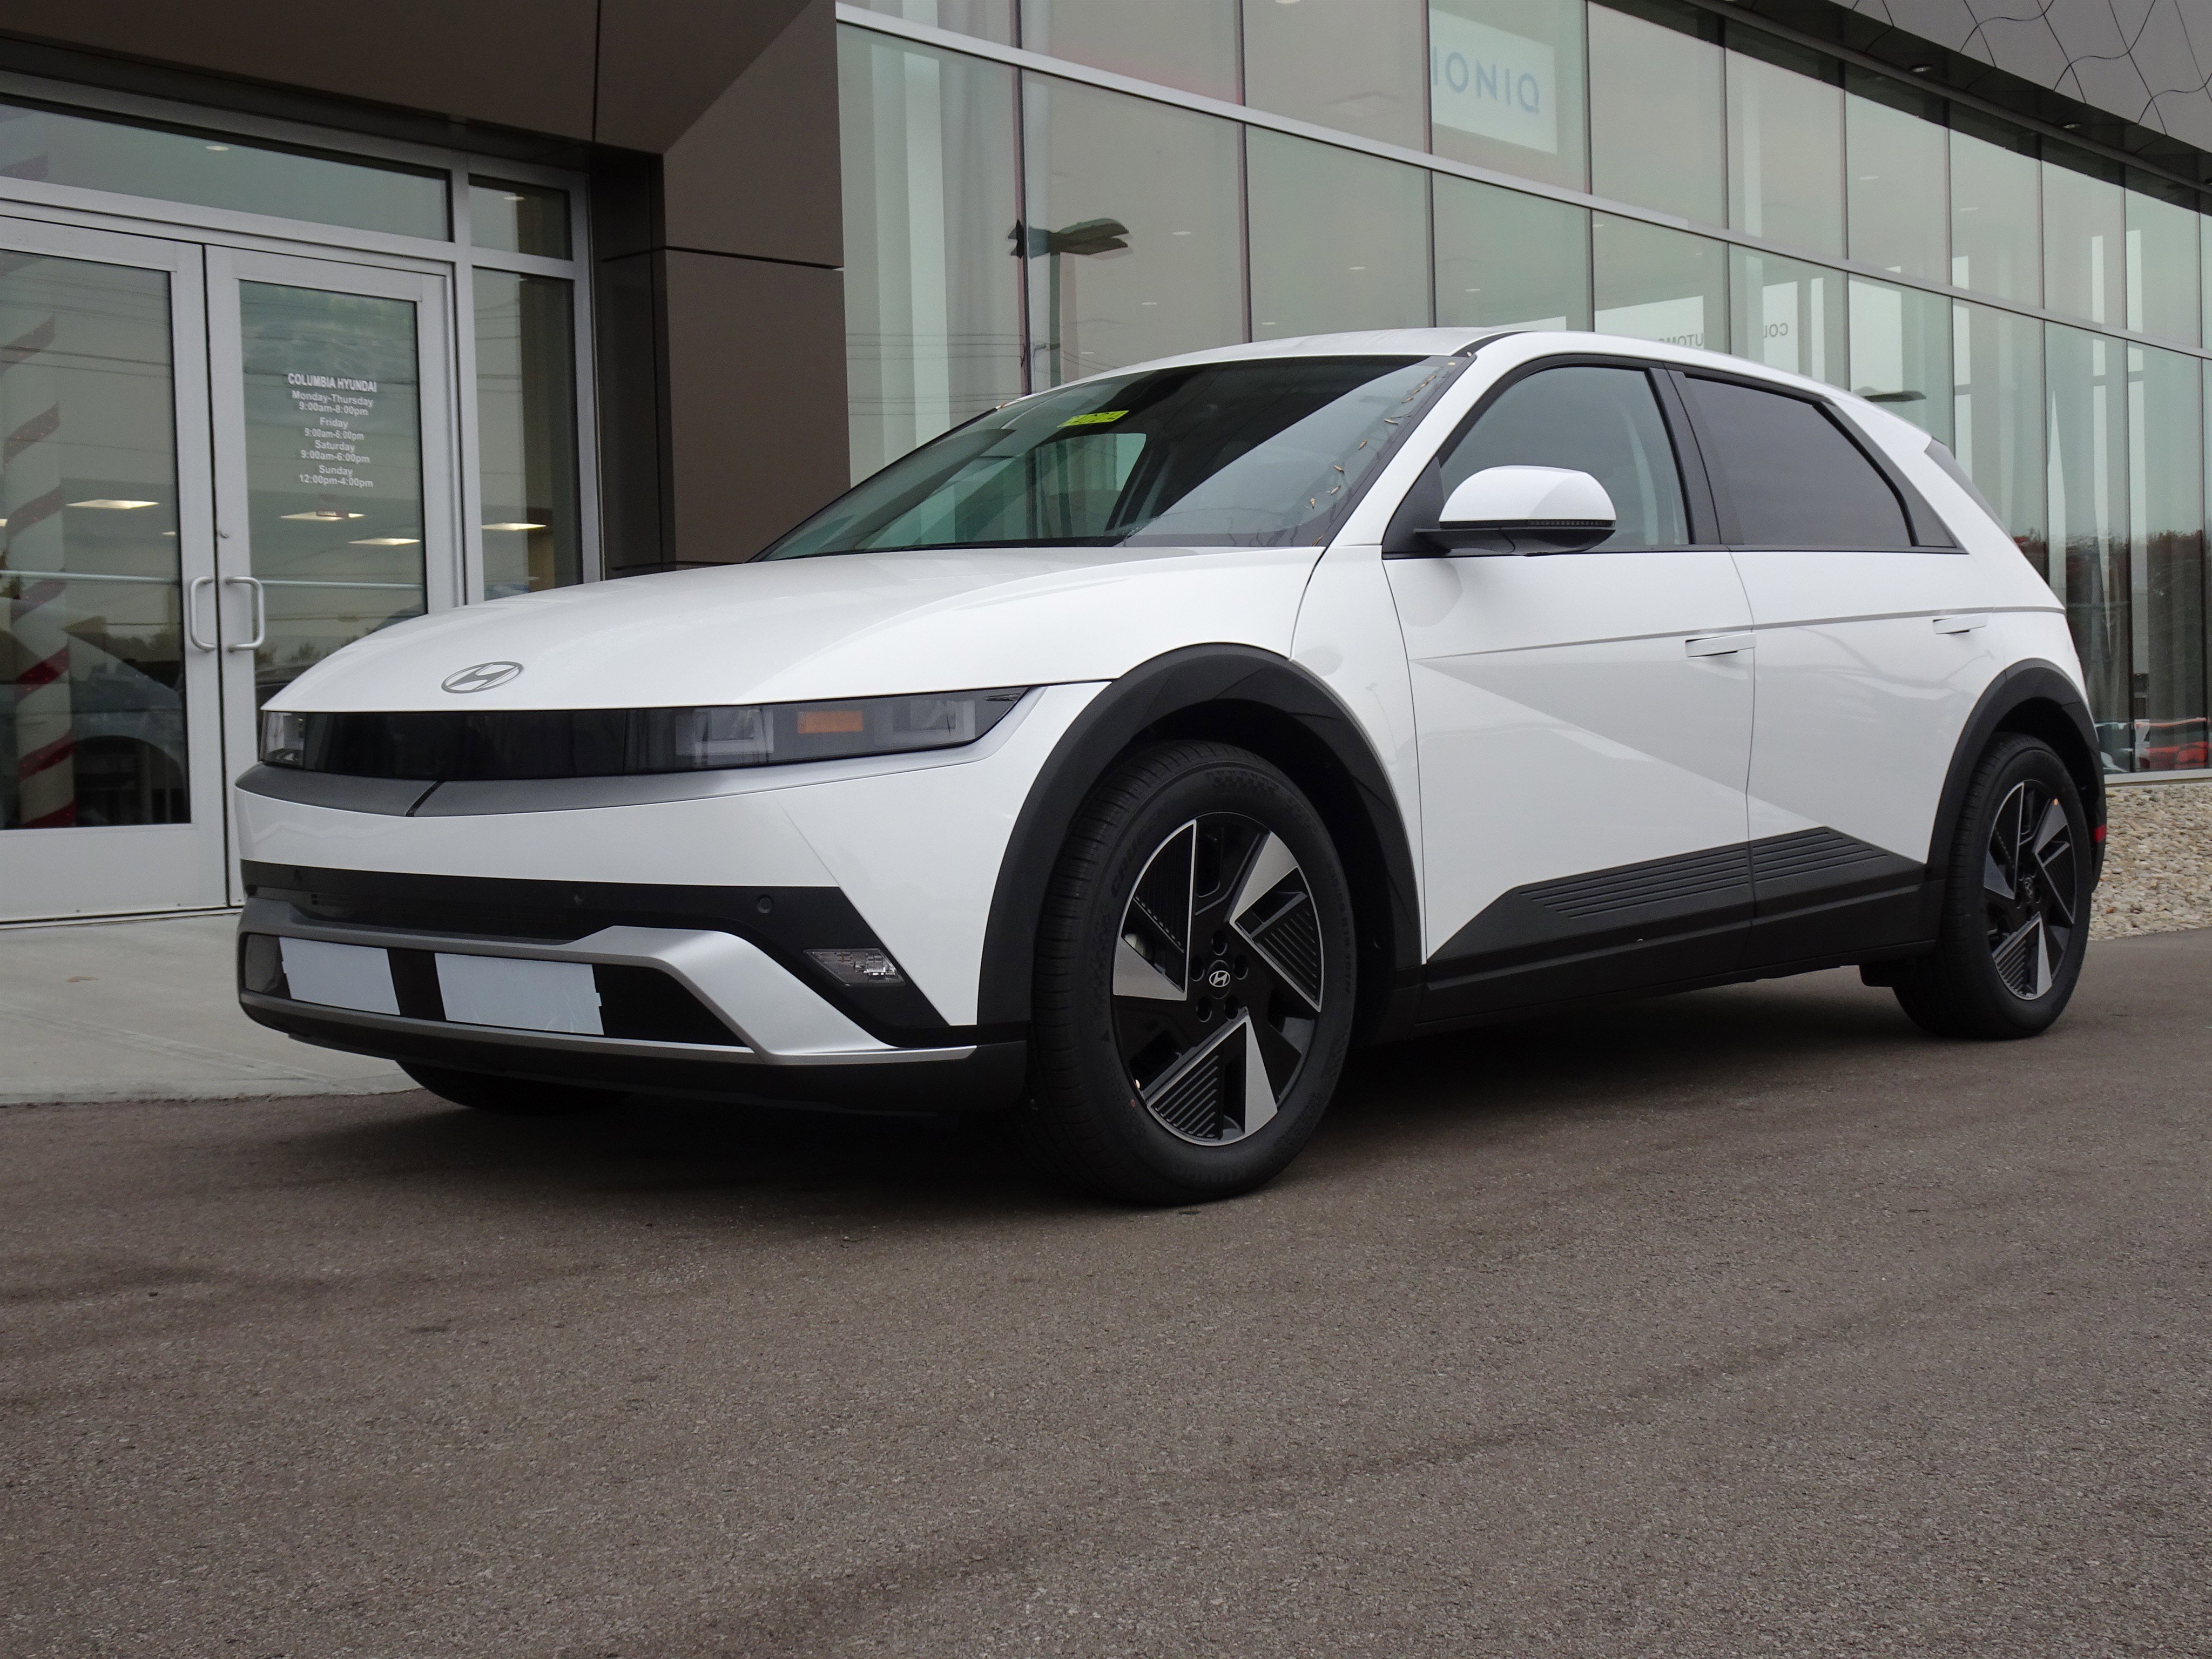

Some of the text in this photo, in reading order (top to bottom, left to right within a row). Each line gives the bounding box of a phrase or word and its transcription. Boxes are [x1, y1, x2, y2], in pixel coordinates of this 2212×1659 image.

[1433, 45, 1539, 114] IONIQ
[287, 373, 377, 393] COLUMBIA HYUNDAI
[292, 390, 374, 408] Monday-Thursday
[299, 402, 368, 416] 9:00am-8:00pm
[320, 417, 348, 429] Friday
[304, 428, 365, 441] 9:00am-6:00pm
[315, 440, 355, 453] Saturday
[300, 450, 370, 464] 9:00am-6:00pm
[319, 465, 353, 477] Sunday
[299, 474, 373, 488] 12:00pm-4:00pm
